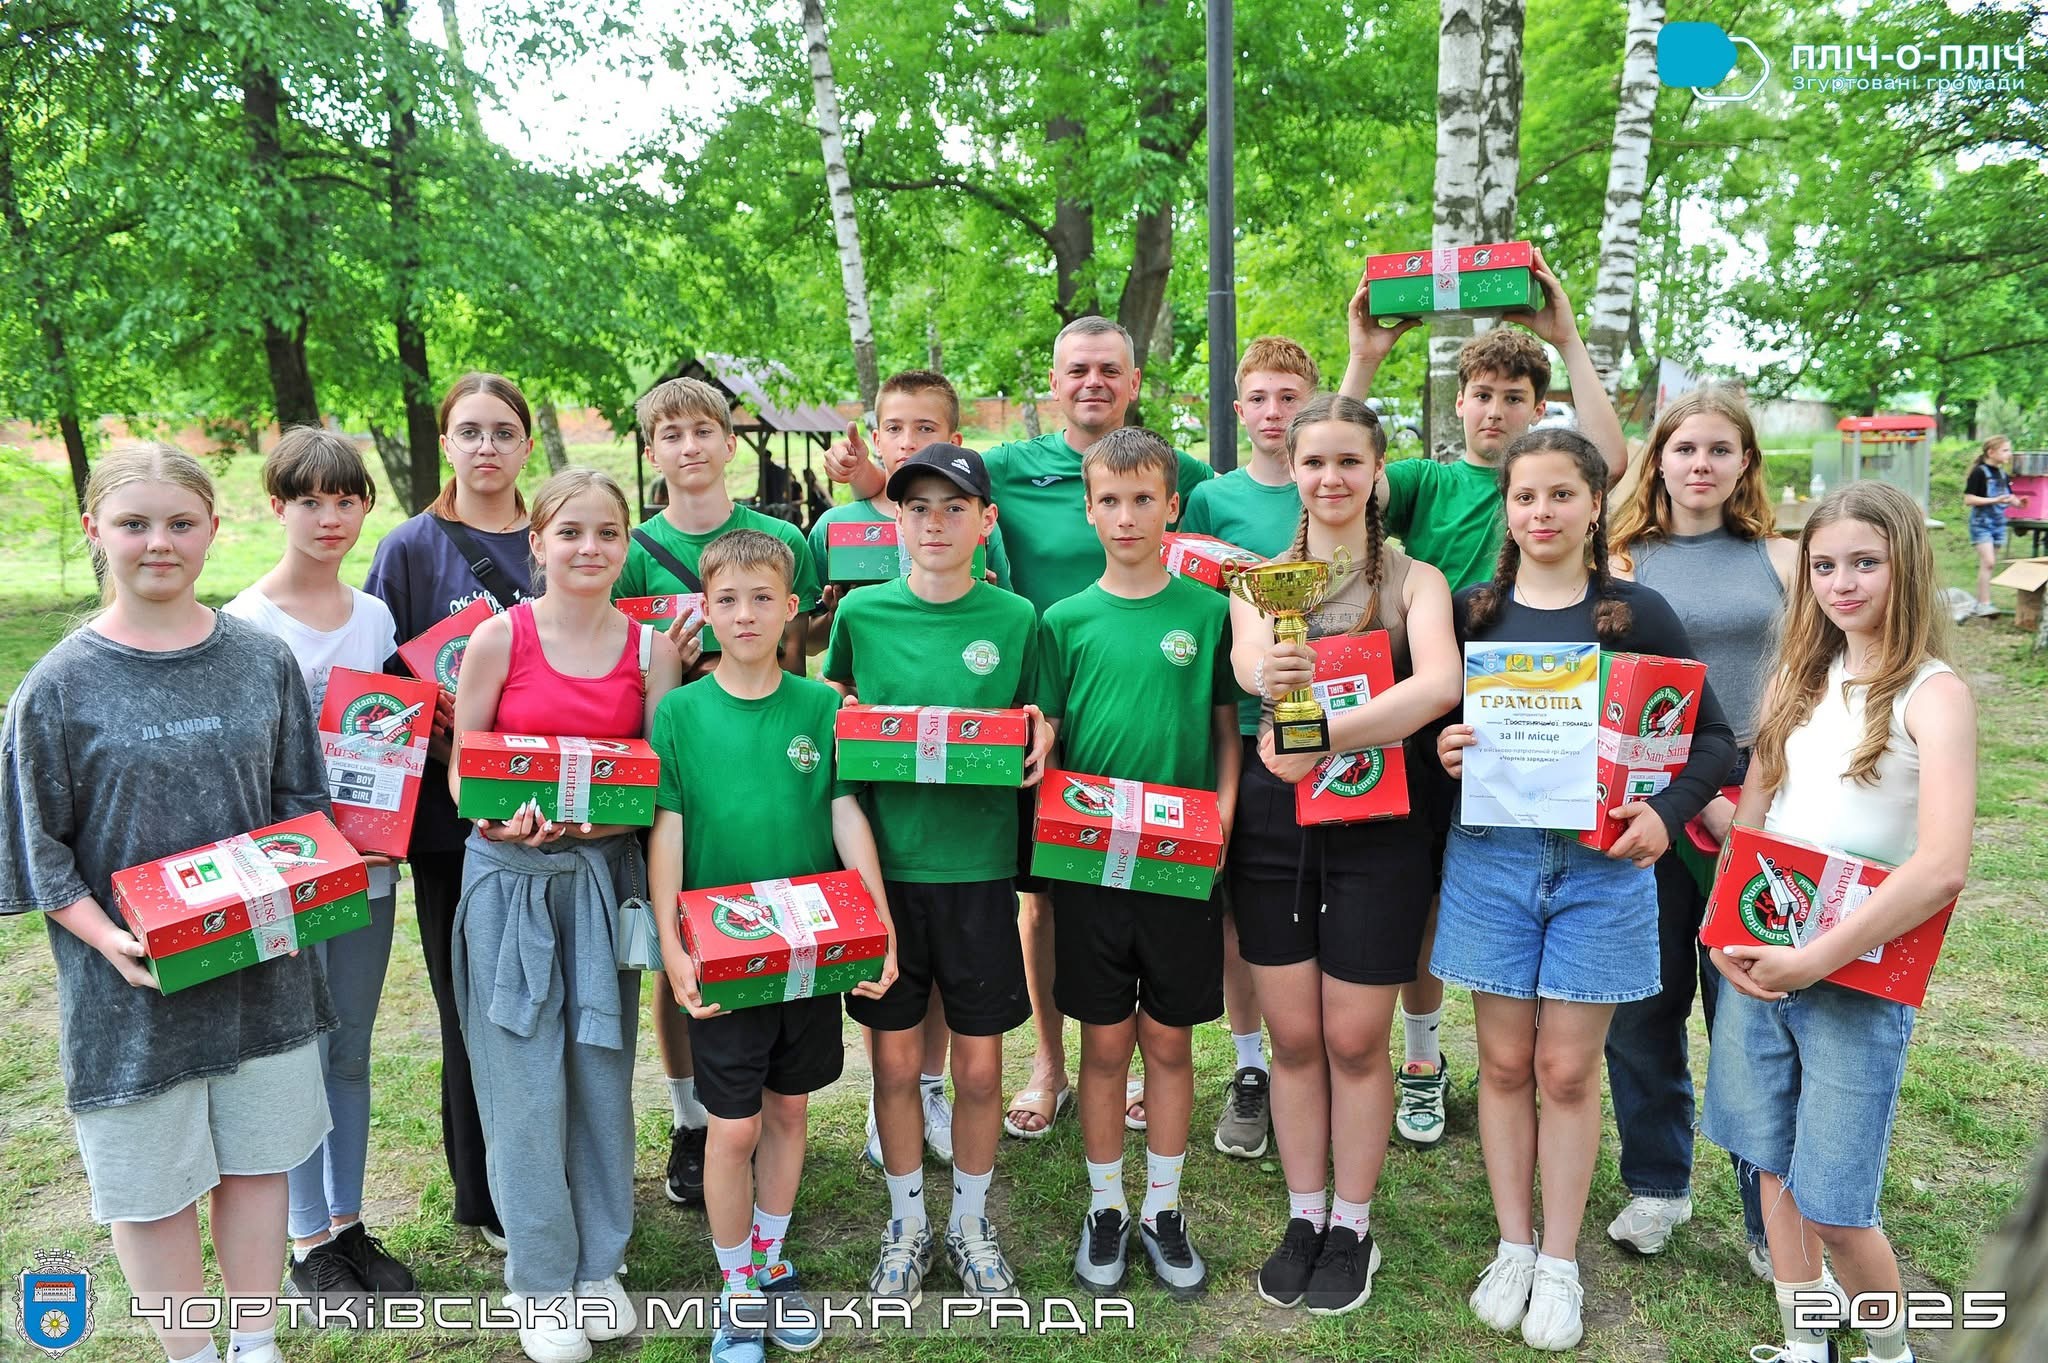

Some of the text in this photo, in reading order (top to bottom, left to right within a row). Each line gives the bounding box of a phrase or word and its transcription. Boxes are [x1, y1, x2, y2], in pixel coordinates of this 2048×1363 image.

[344, 694, 401, 736] Samaritan's Purse
[141, 716, 222, 741] JIL SANDER
[1527, 731, 1560, 742] місце
[324, 742, 362, 760] Purse
[356, 774, 374, 785] BOY
[1331, 780, 1356, 795] Purse
[352, 790, 370, 801] GIRL
[1111, 848, 1129, 880] Purse
[1798, 878, 1816, 896] Child
[1785, 875, 1809, 919] OPERATION
[1743, 878, 1790, 944] Samaritan's Purse
